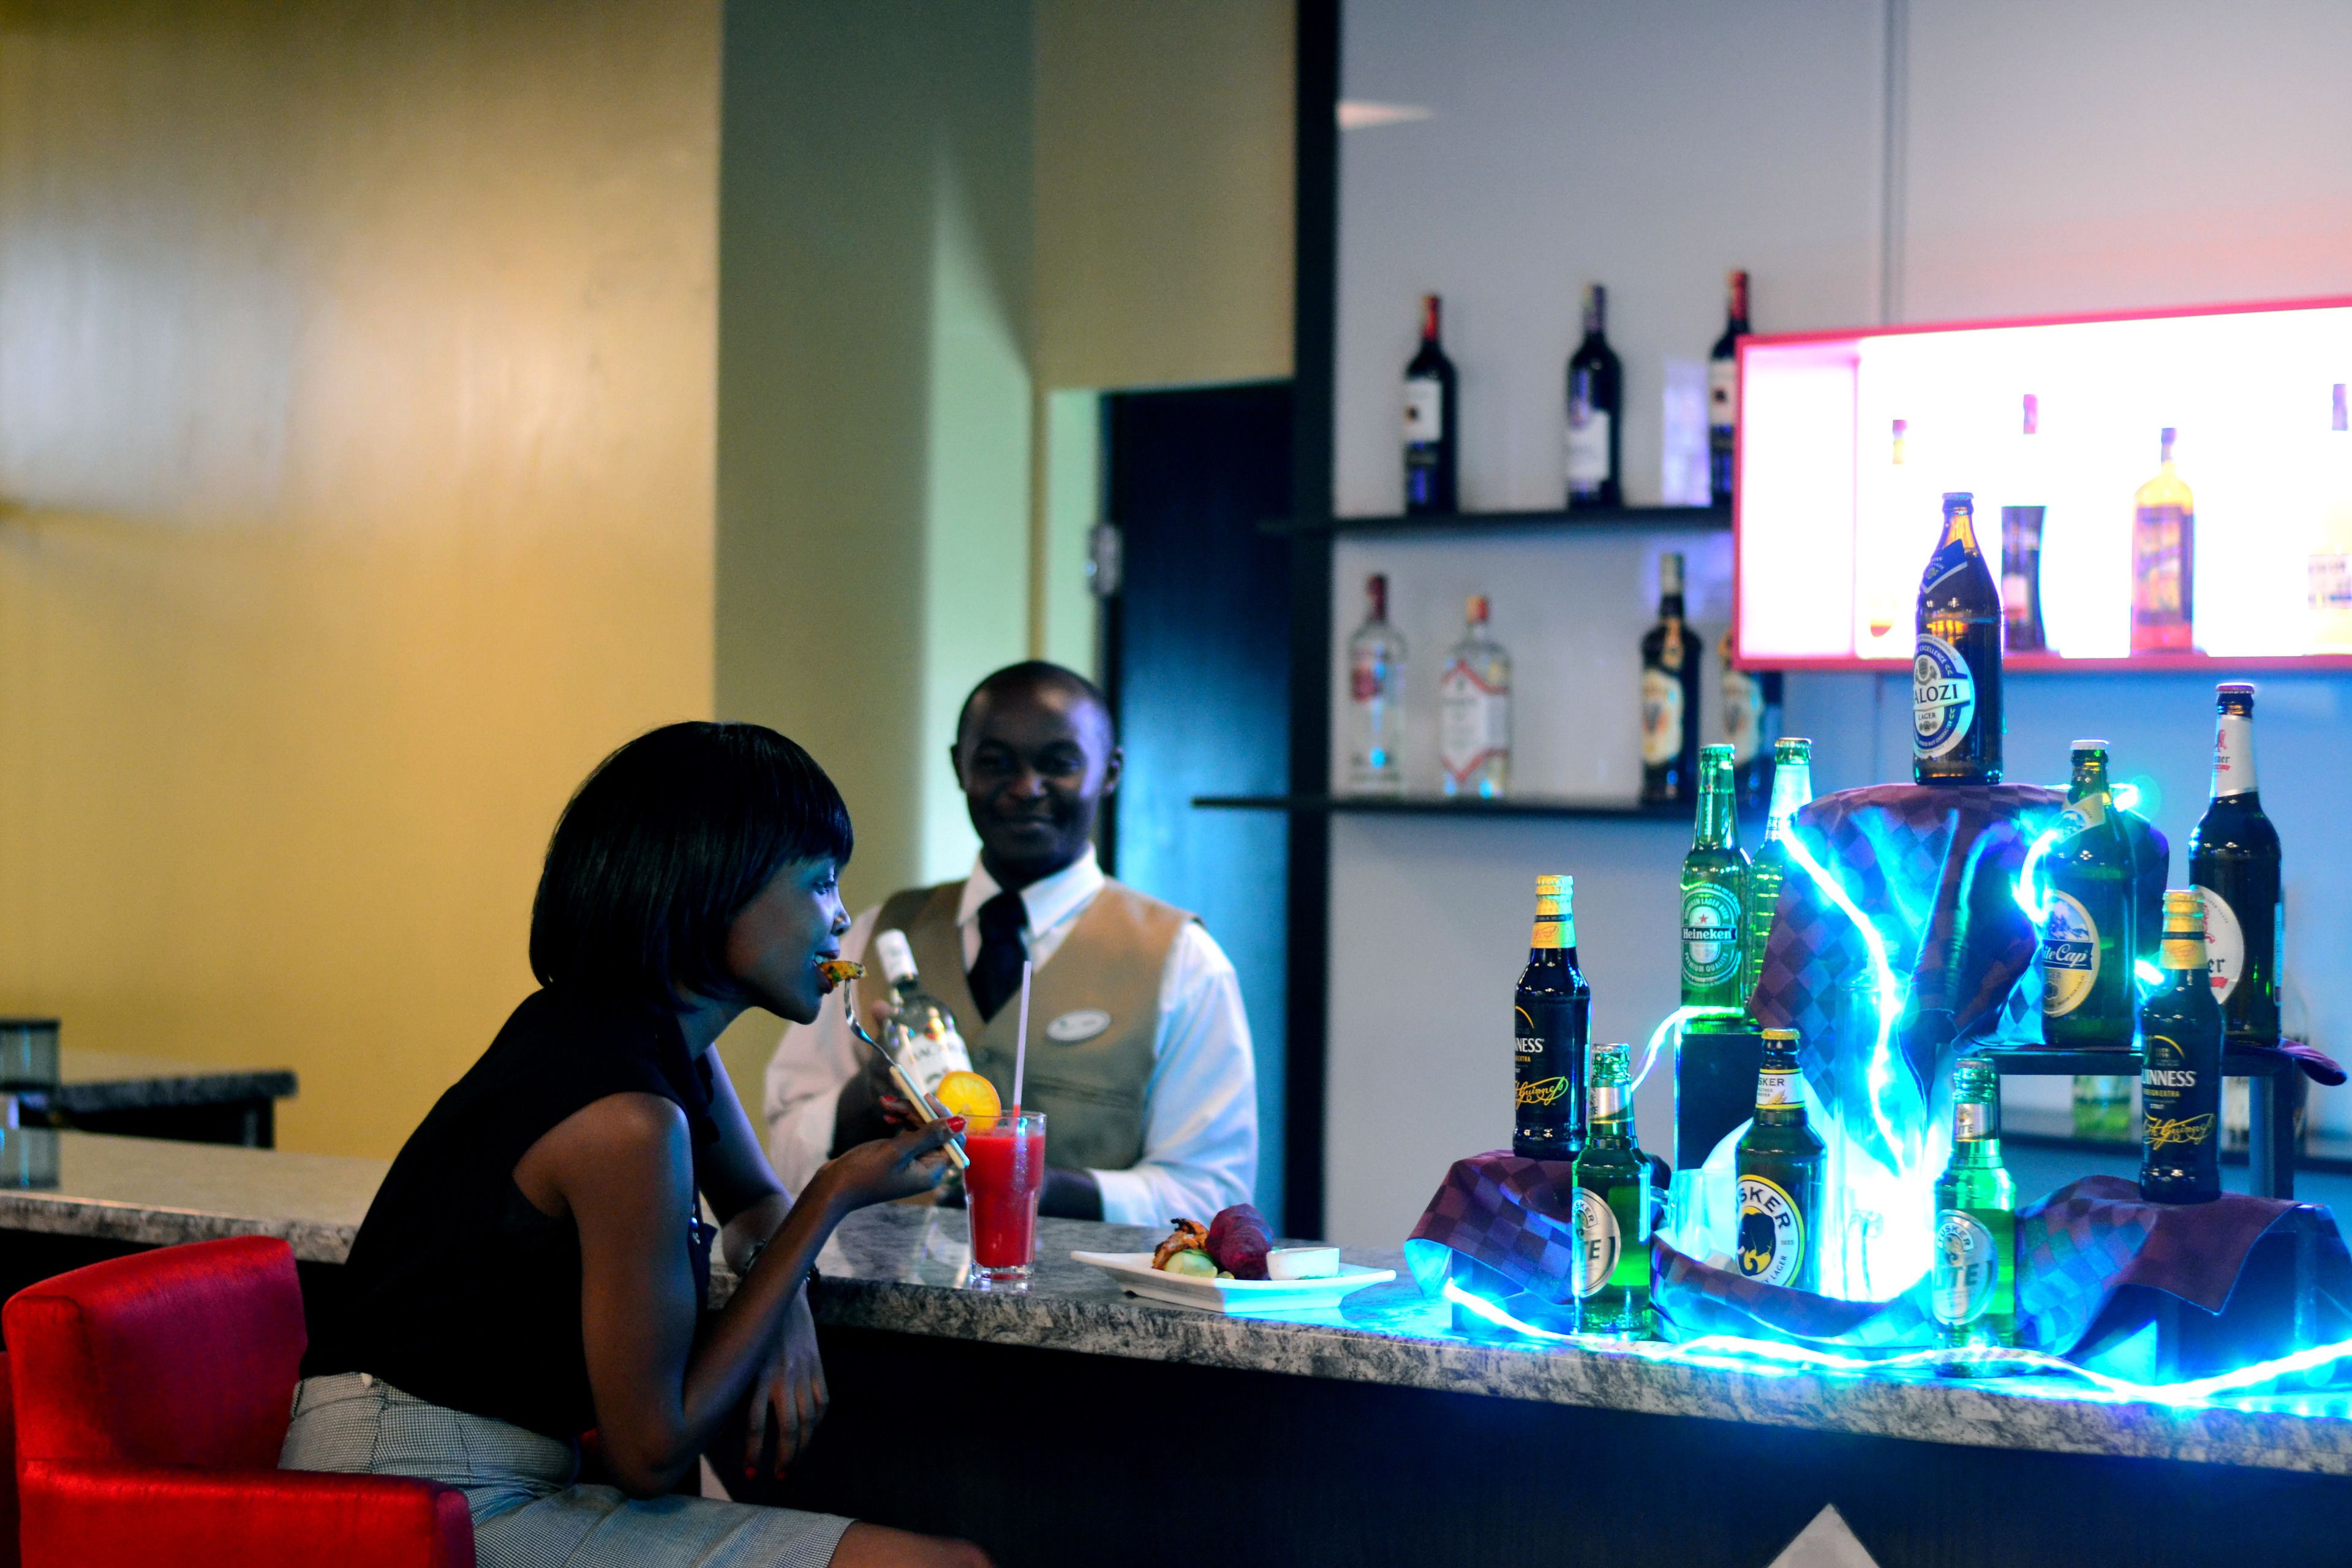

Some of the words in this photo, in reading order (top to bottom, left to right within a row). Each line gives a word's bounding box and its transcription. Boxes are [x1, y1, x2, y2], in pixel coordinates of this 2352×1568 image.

[1918, 712, 1936, 721] LAGER
[1702, 897, 1721, 908] LAGER
[1683, 927, 1732, 940] Heineken
[1684, 951, 1705, 973] PREMIUM
[1705, 951, 1729, 973] QUALITY
[2056, 943, 2087, 968] Cap
[1938, 1224, 1971, 1246] TUSKER
[1770, 1255, 1787, 1281] LAGER
